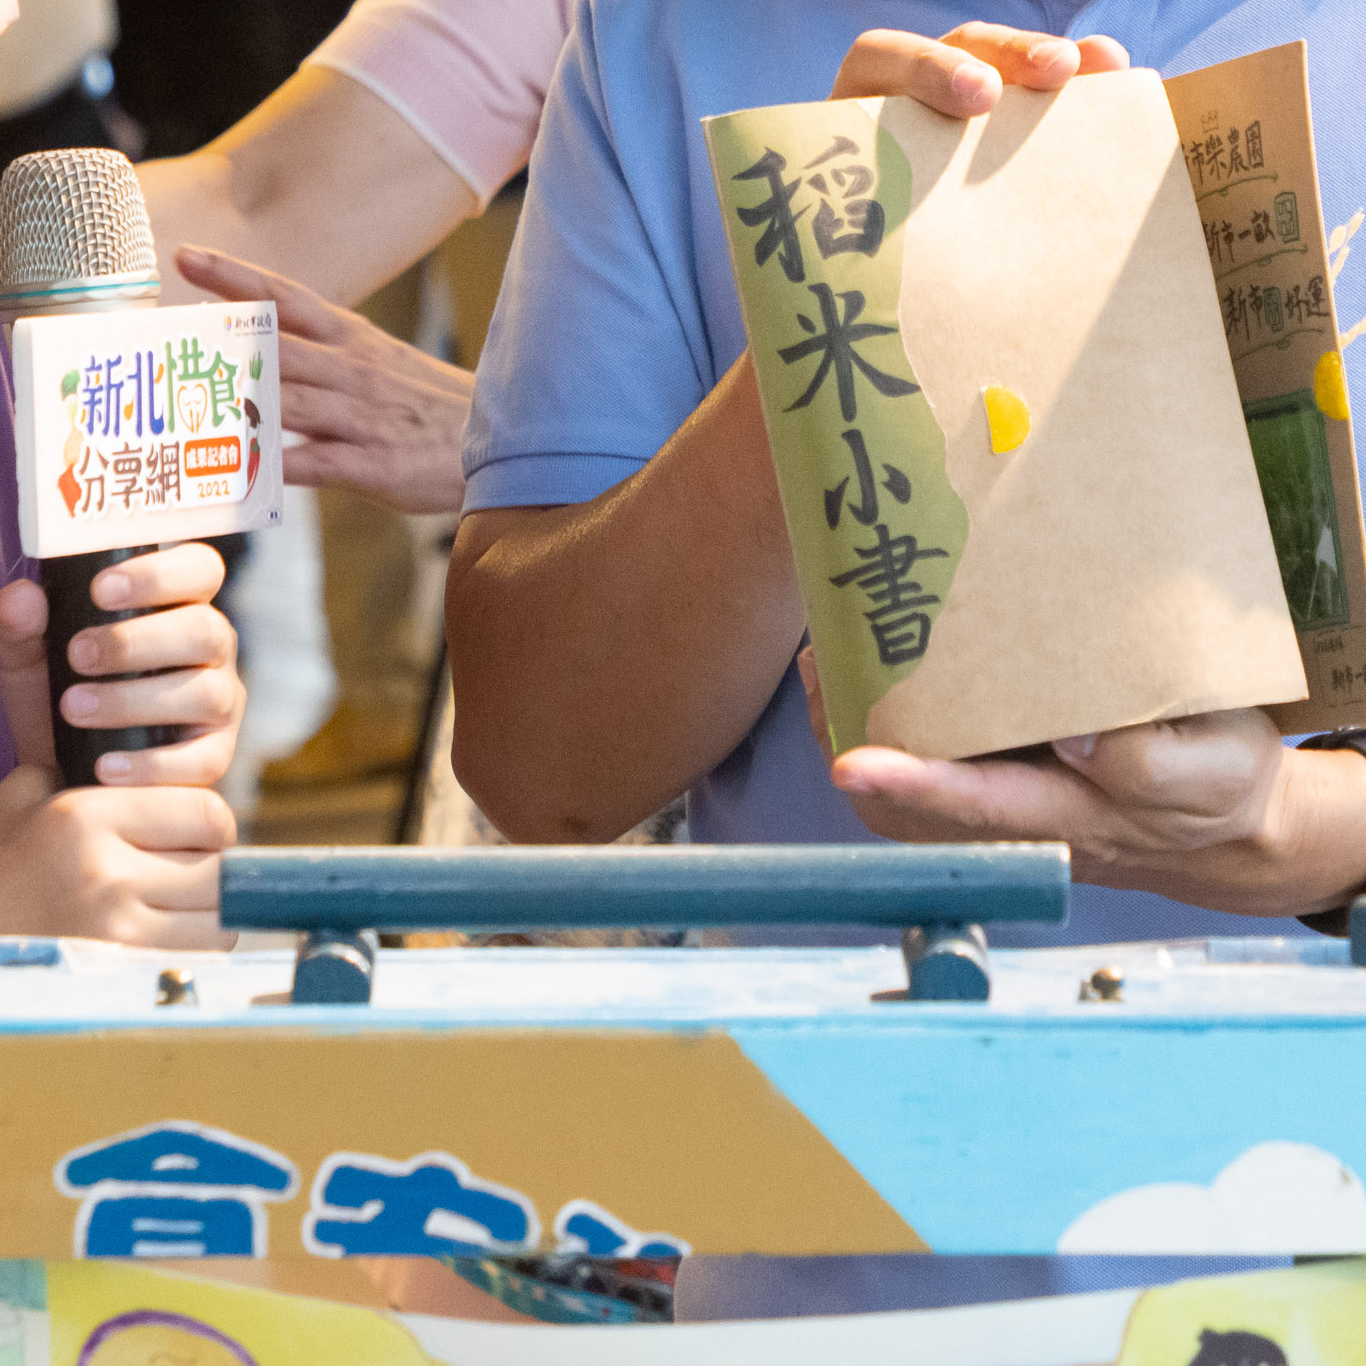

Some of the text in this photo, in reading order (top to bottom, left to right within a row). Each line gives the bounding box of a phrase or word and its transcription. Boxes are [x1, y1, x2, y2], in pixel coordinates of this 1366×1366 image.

[79, 337, 242, 437] 新北惜食
[731, 135, 950, 667] 稻米小書
[79, 440, 182, 513] 分享網
[186, 443, 238, 470] 成果記者會
[197, 479, 230, 498] 2022
